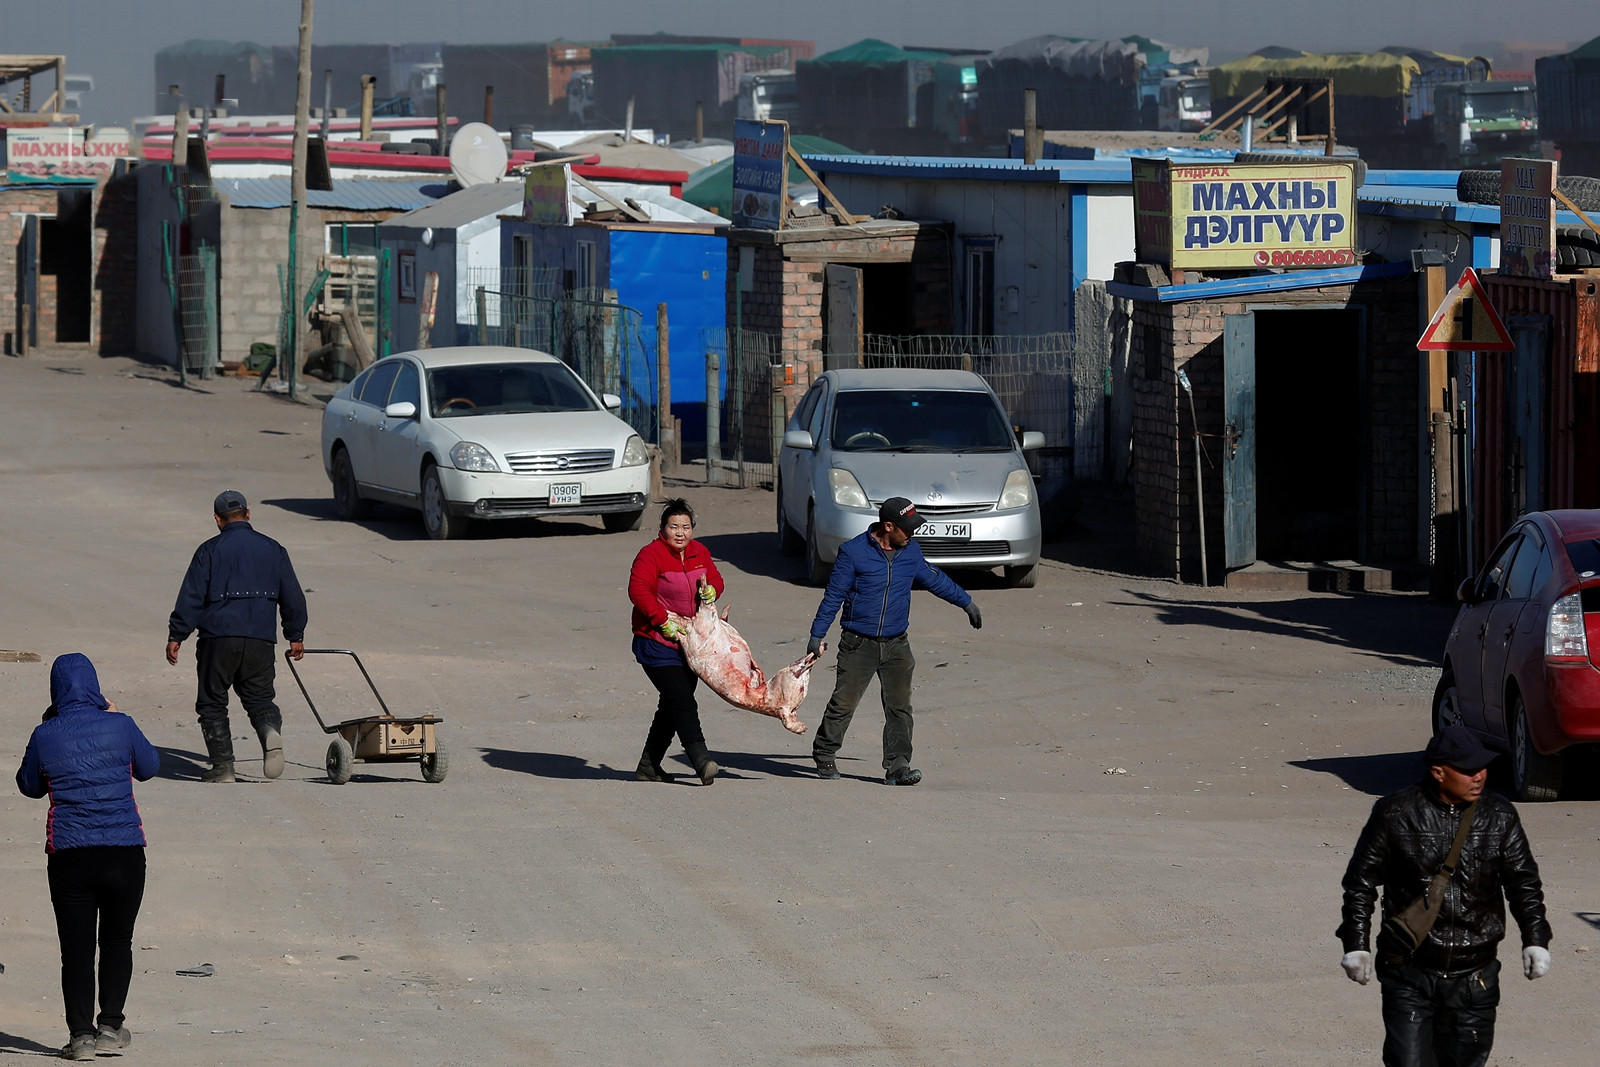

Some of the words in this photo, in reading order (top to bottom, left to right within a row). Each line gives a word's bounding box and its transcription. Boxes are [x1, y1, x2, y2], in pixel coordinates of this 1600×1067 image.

[1515, 167, 1535, 189] МАХ
[1191, 180, 1337, 212] МАХНЫ
[1503, 194, 1548, 220] НОГООНЫ
[1184, 213, 1345, 249] ДЭЛГҮҮР
[1271, 250, 1354, 266] 80668067
[553, 486, 577, 495] 0906
[944, 525, 966, 536] УБИ
